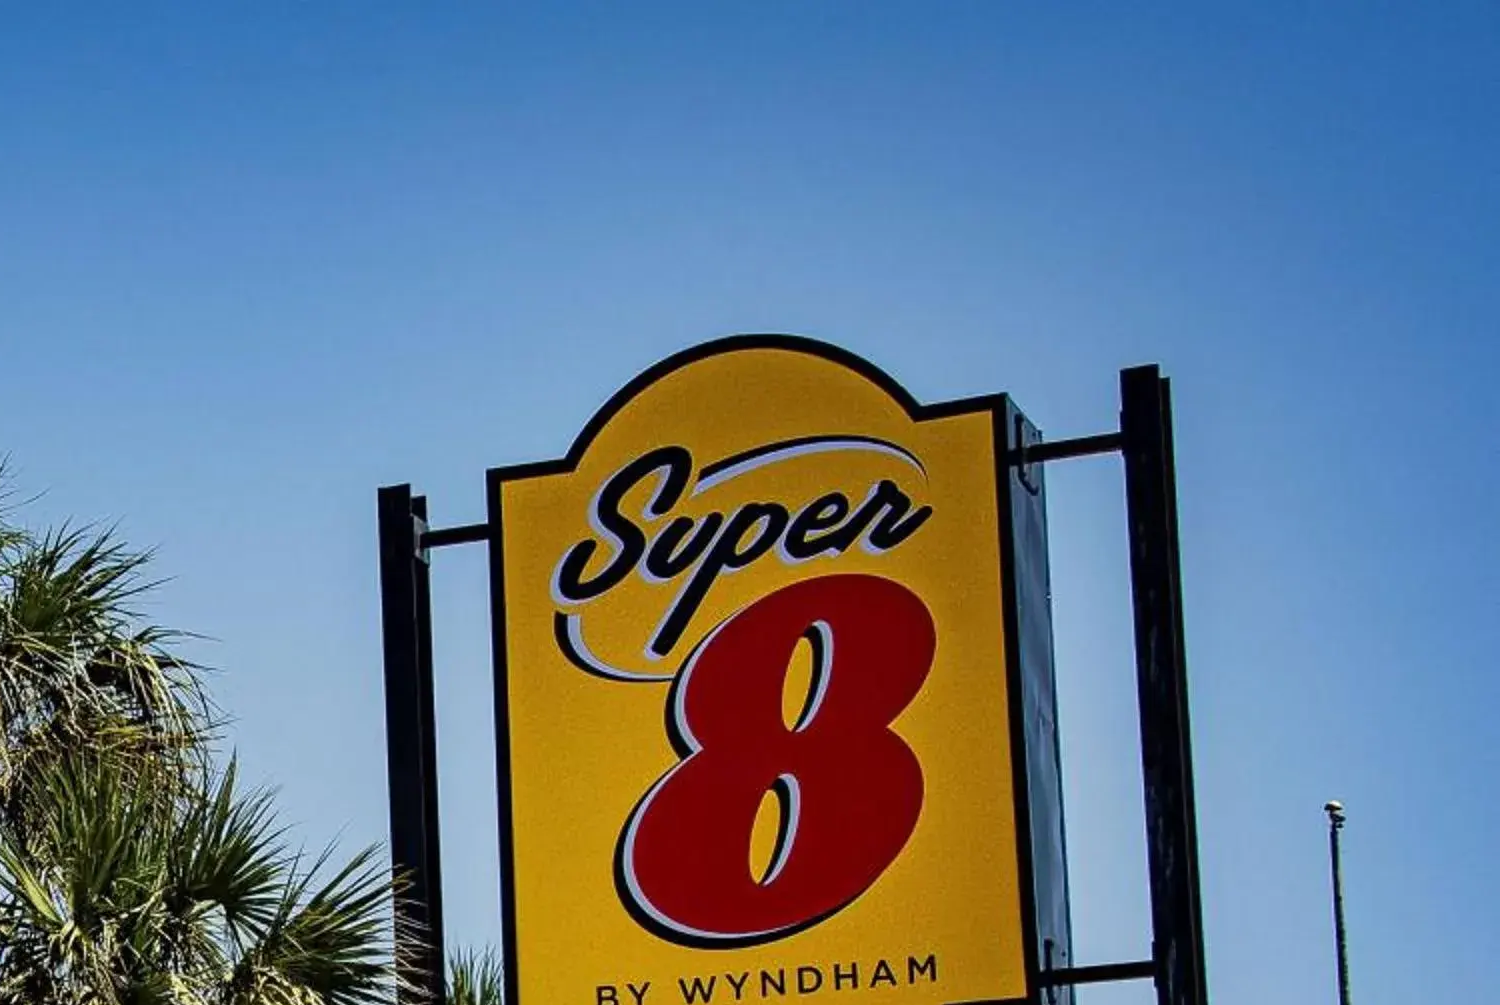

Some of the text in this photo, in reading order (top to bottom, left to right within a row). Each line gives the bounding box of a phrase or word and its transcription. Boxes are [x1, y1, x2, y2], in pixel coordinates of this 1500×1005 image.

[552, 446, 933, 659] Super
[613, 573, 937, 950] 8
[678, 953, 938, 1005] WYNDHAM
